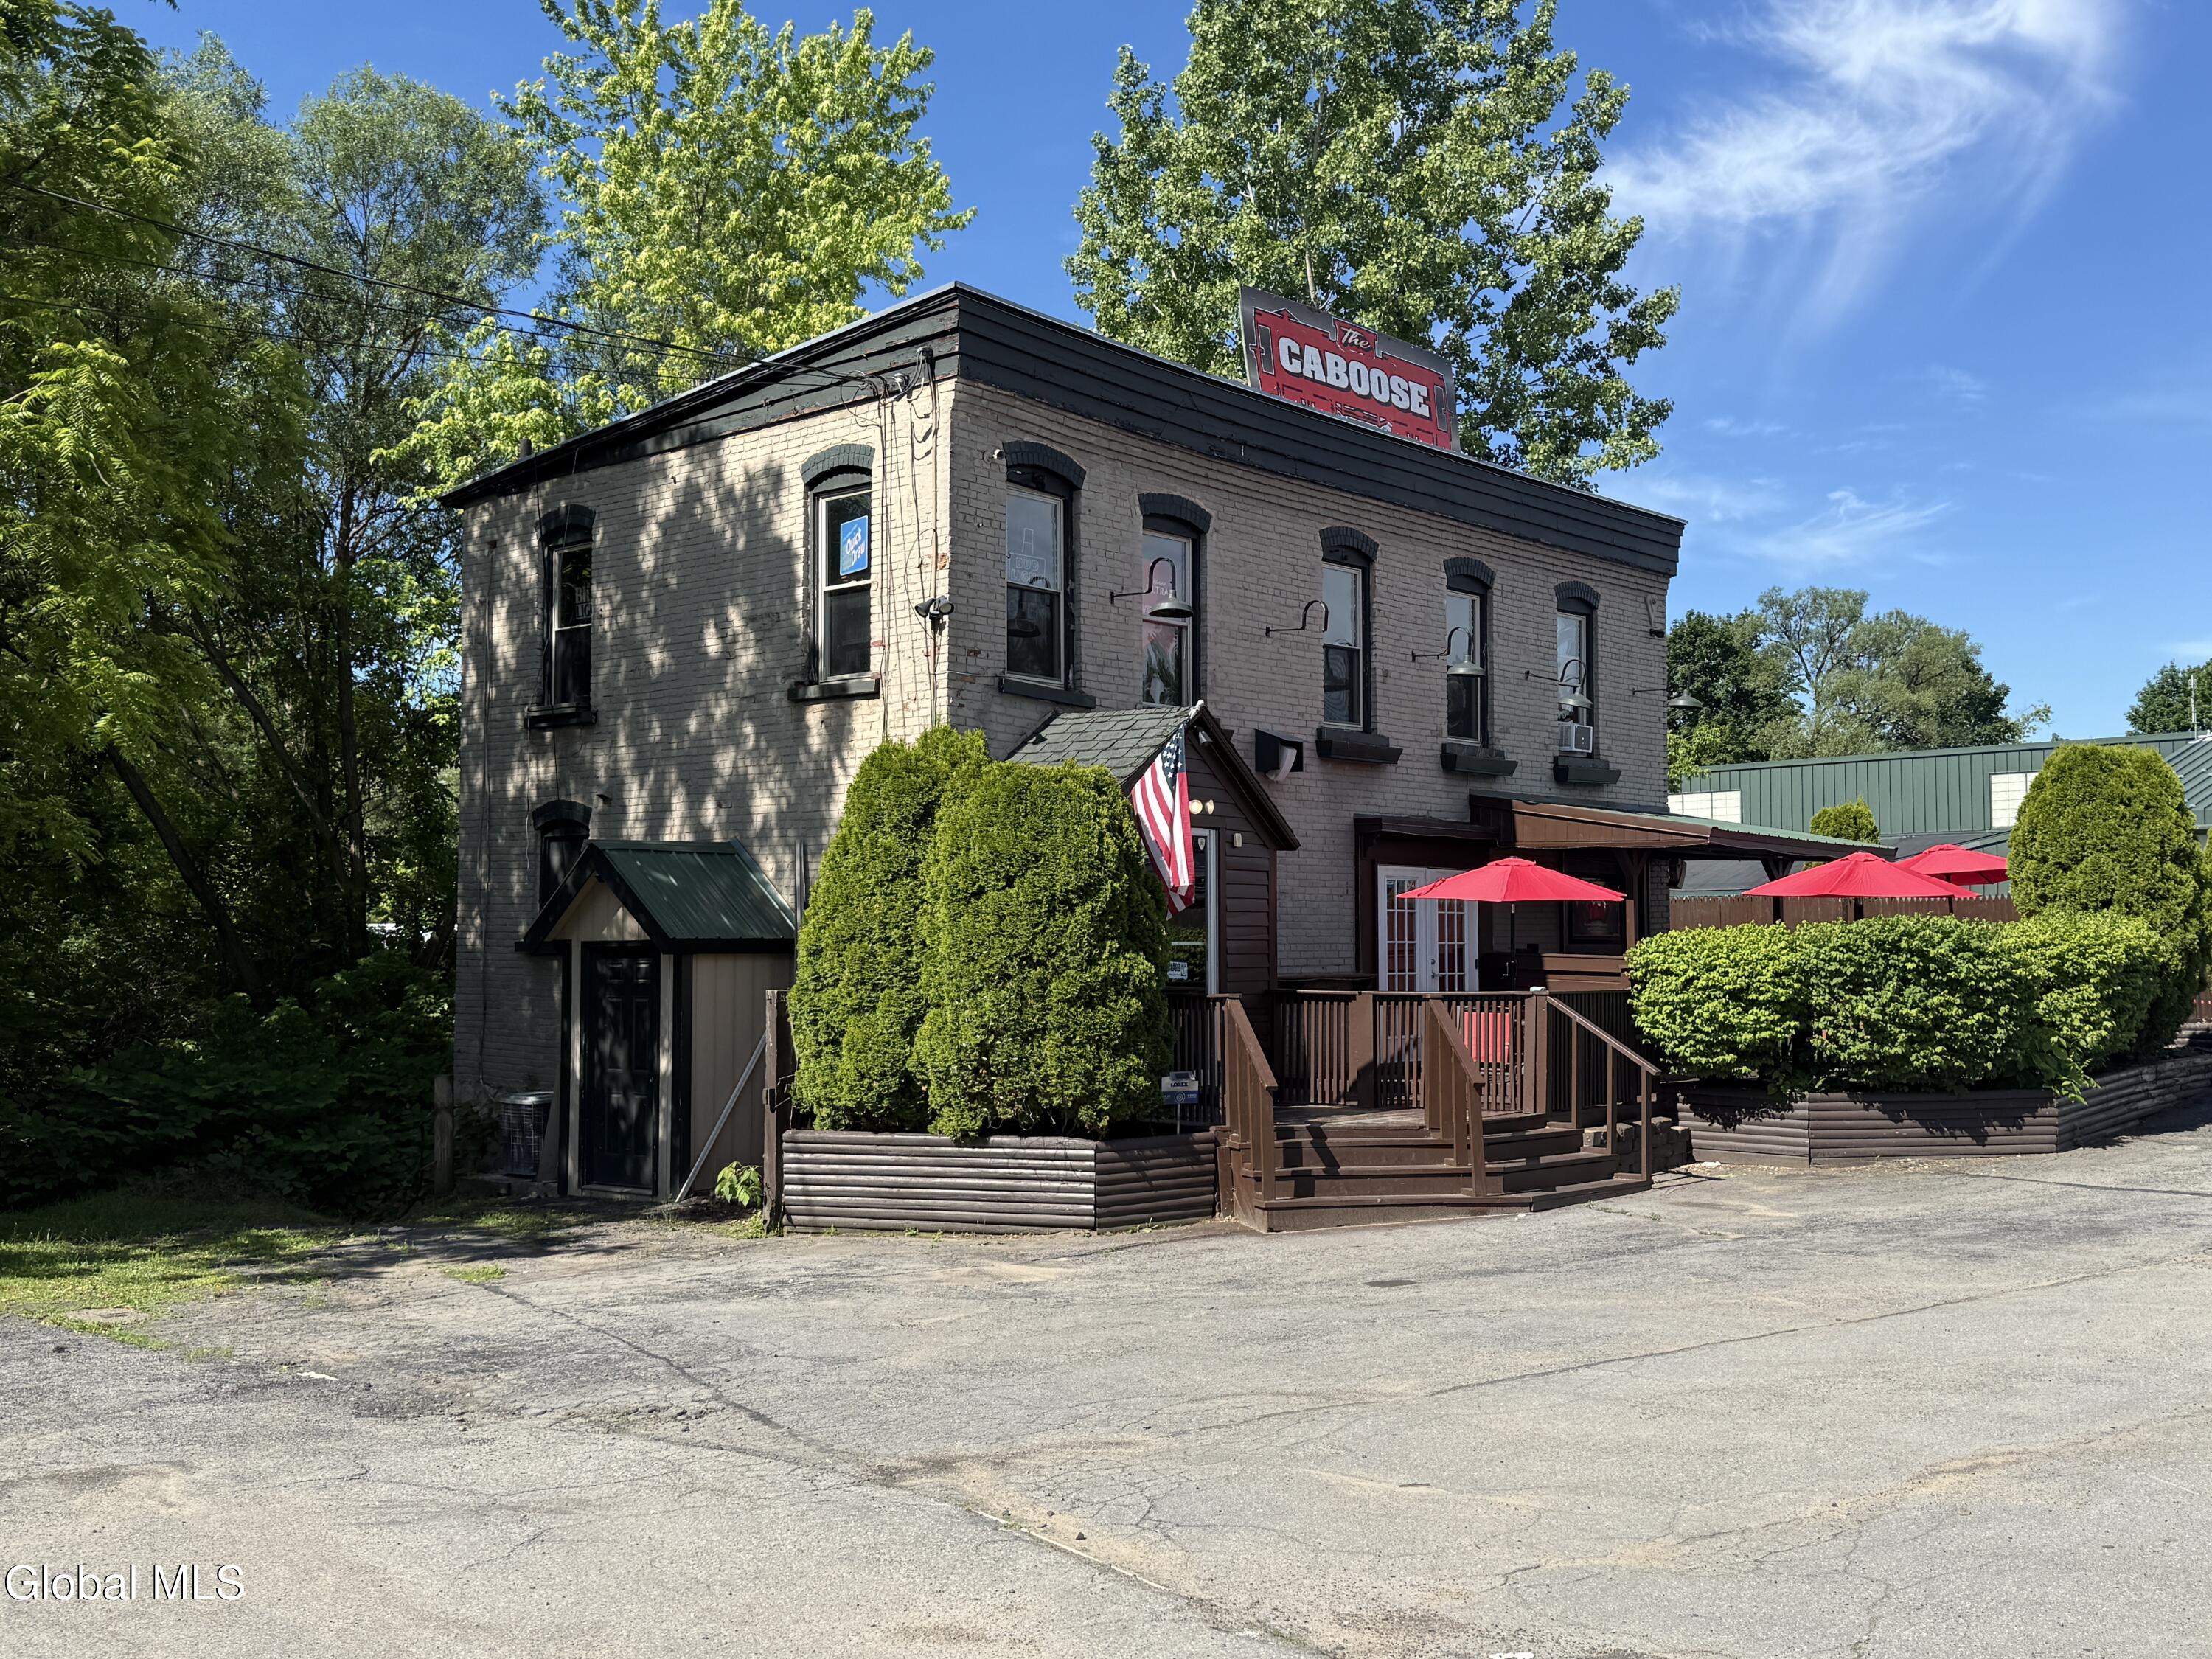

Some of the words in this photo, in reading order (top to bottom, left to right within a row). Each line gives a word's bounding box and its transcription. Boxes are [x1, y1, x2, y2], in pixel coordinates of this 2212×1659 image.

[1340, 327, 1371, 349] The
[1278, 336, 1432, 418] CABOOSE
[846, 526, 862, 555] Quick
[851, 540, 866, 567] Draw
[1015, 557, 1040, 571] BUD
[1152, 585, 1169, 596] LTRA
